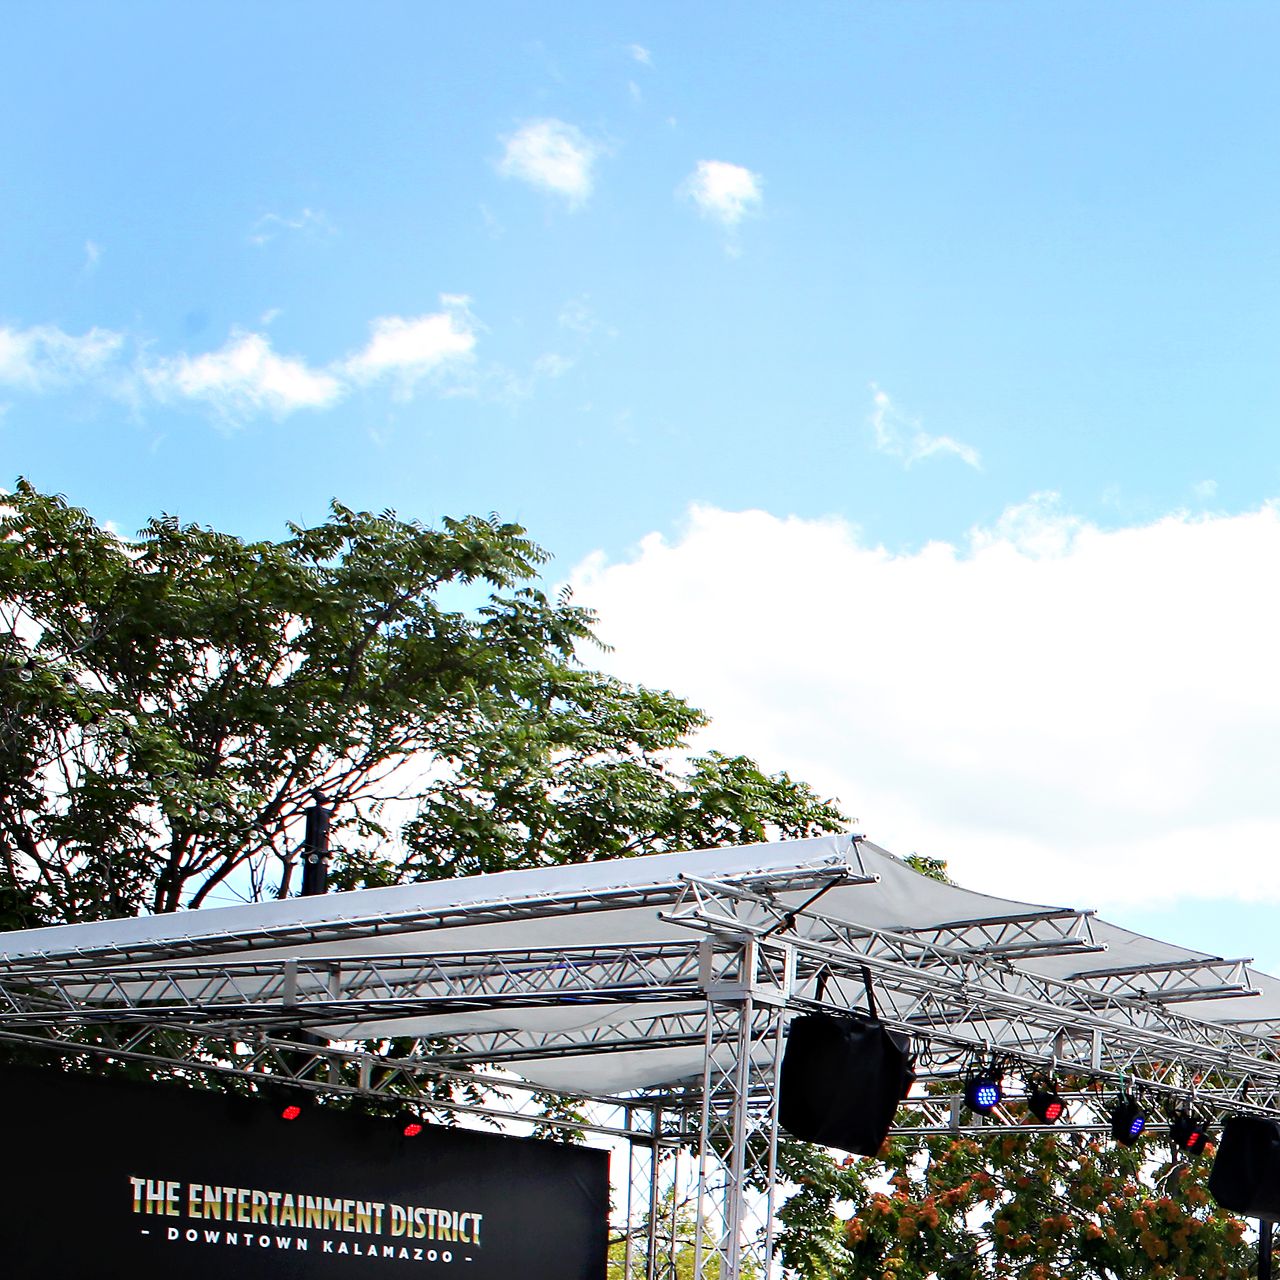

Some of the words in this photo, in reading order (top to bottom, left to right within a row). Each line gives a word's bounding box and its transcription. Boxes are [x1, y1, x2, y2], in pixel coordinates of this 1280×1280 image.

[130, 1176, 181, 1217] THE
[188, 1183, 385, 1235] ENTERTAINMENT
[390, 1203, 483, 1247] DISTRICT
[167, 1227, 308, 1250] DOWNTOWN
[322, 1240, 453, 1263] KALAMAZOO
